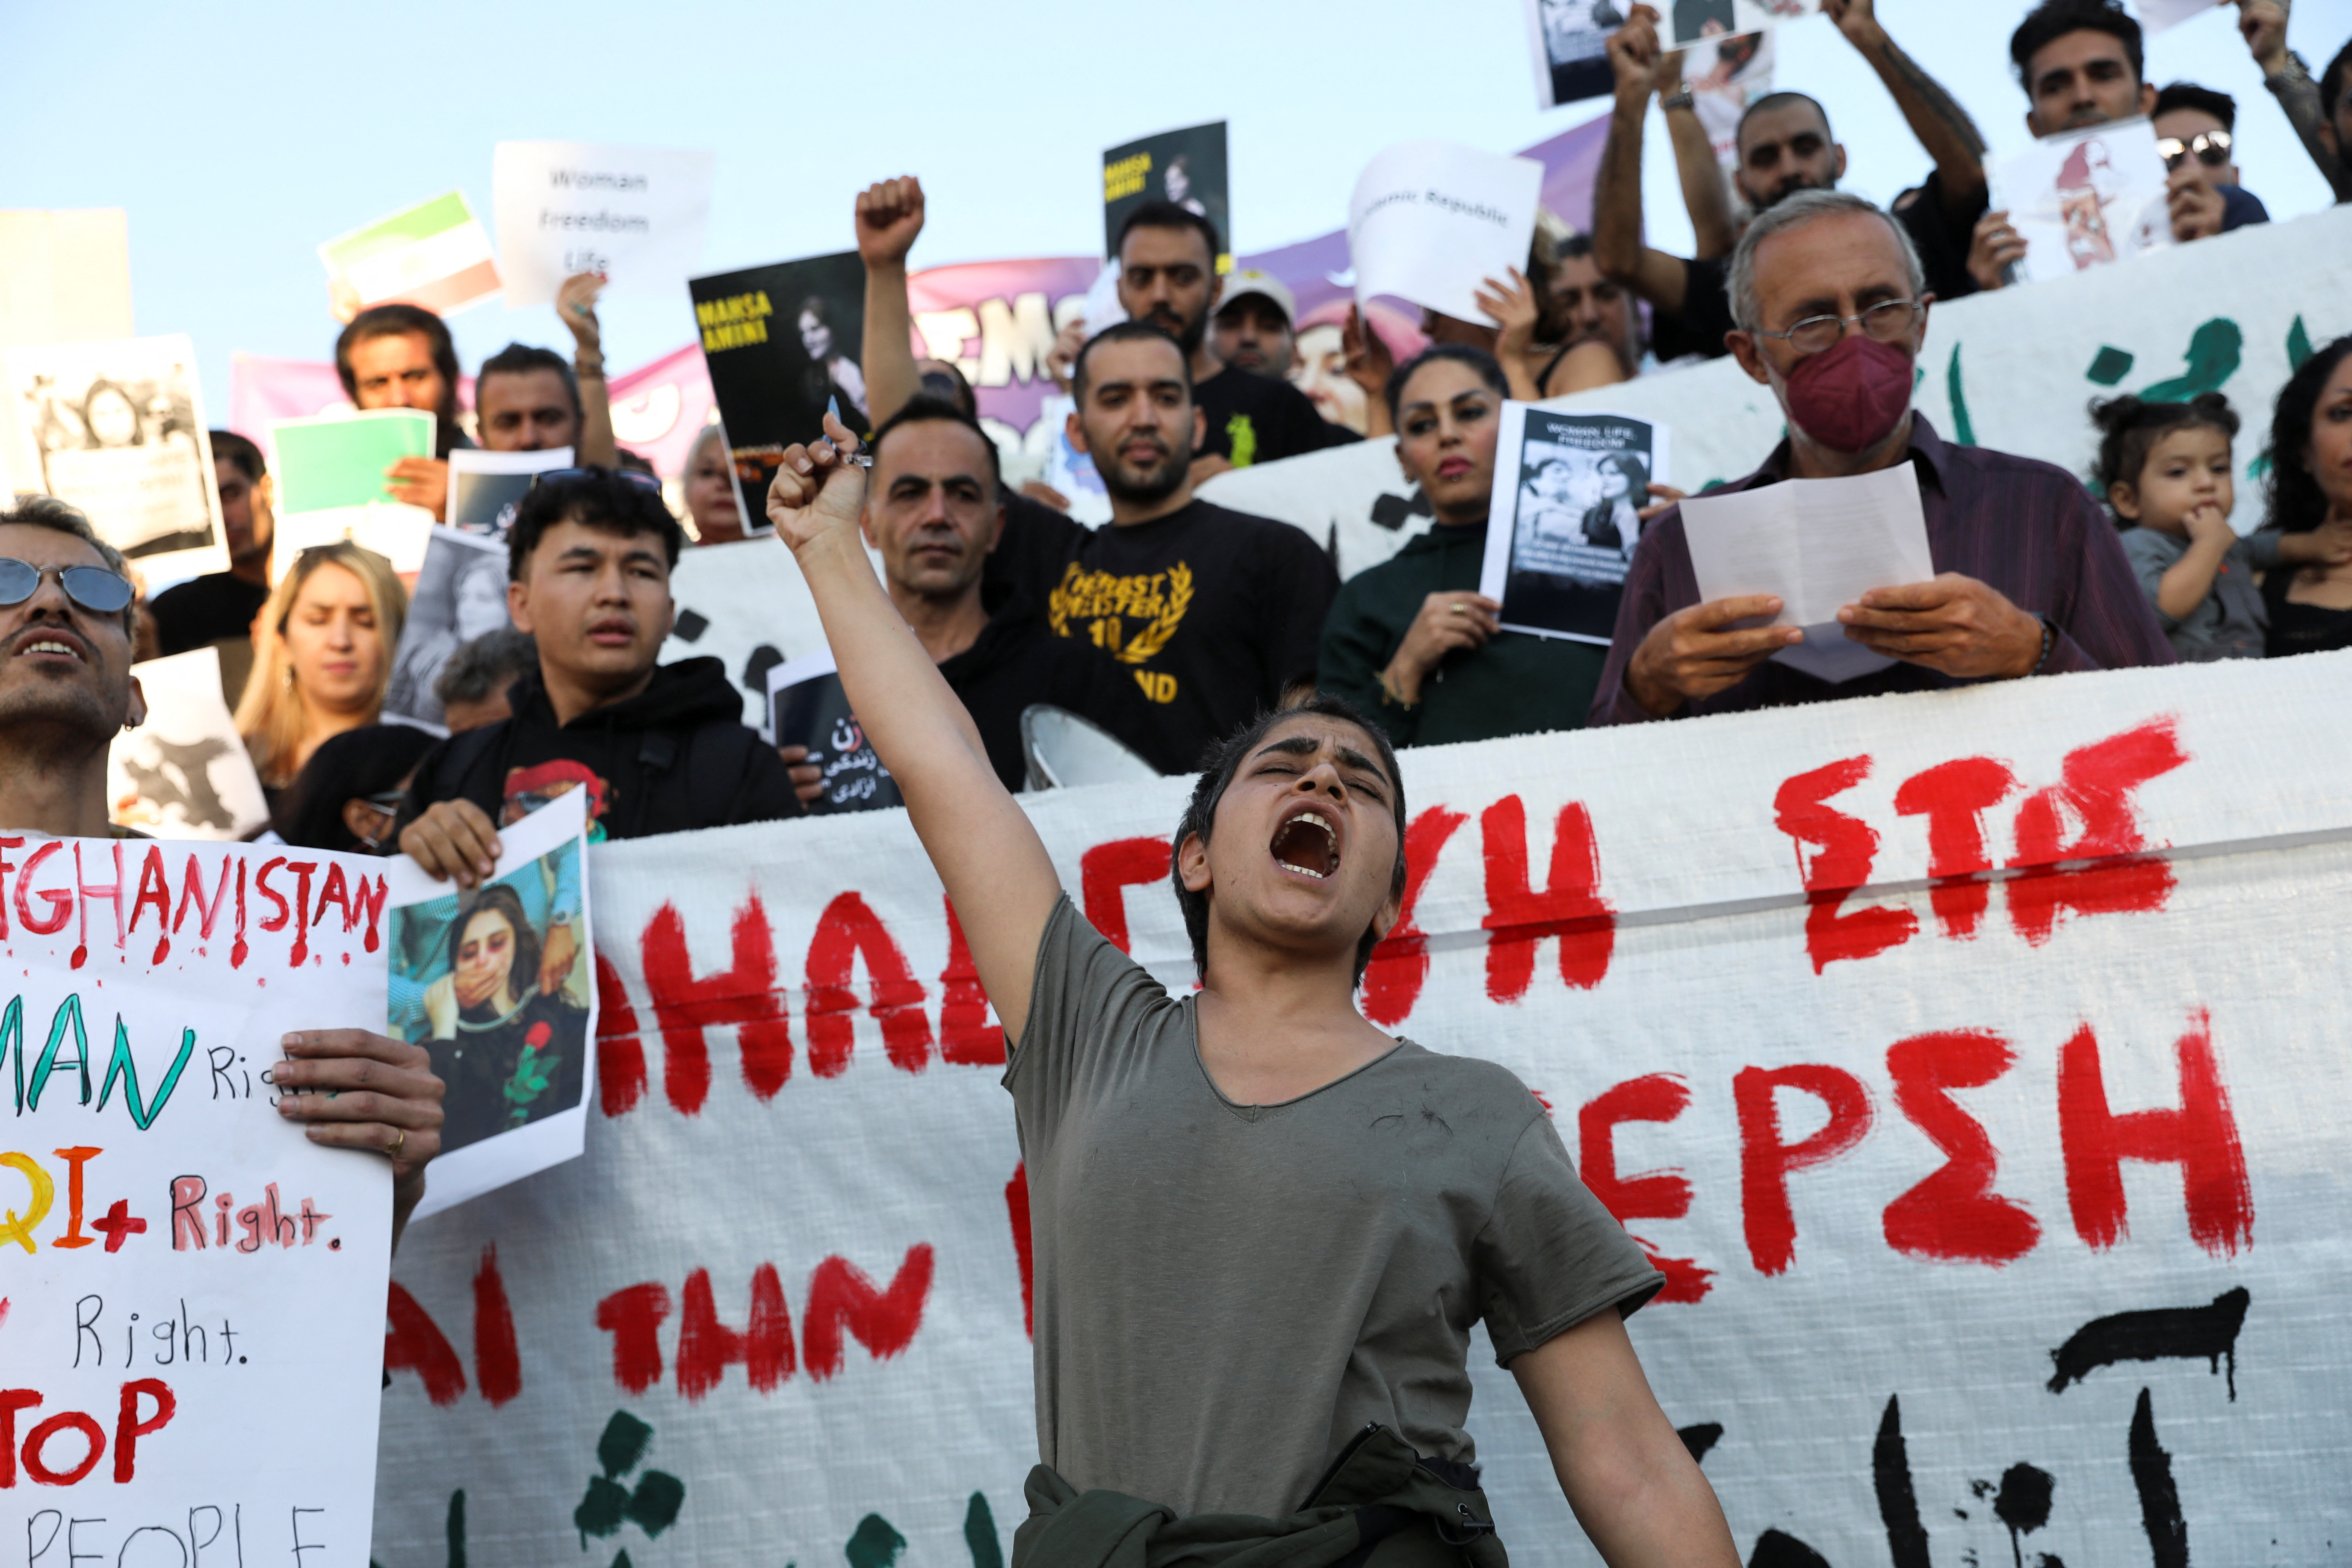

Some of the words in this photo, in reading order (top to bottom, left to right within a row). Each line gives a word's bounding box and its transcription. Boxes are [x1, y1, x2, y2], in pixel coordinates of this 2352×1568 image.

[550, 168, 648, 192] Woman
[170, 1174, 341, 1253] Right.
[74, 1295, 247, 1369] Right.
